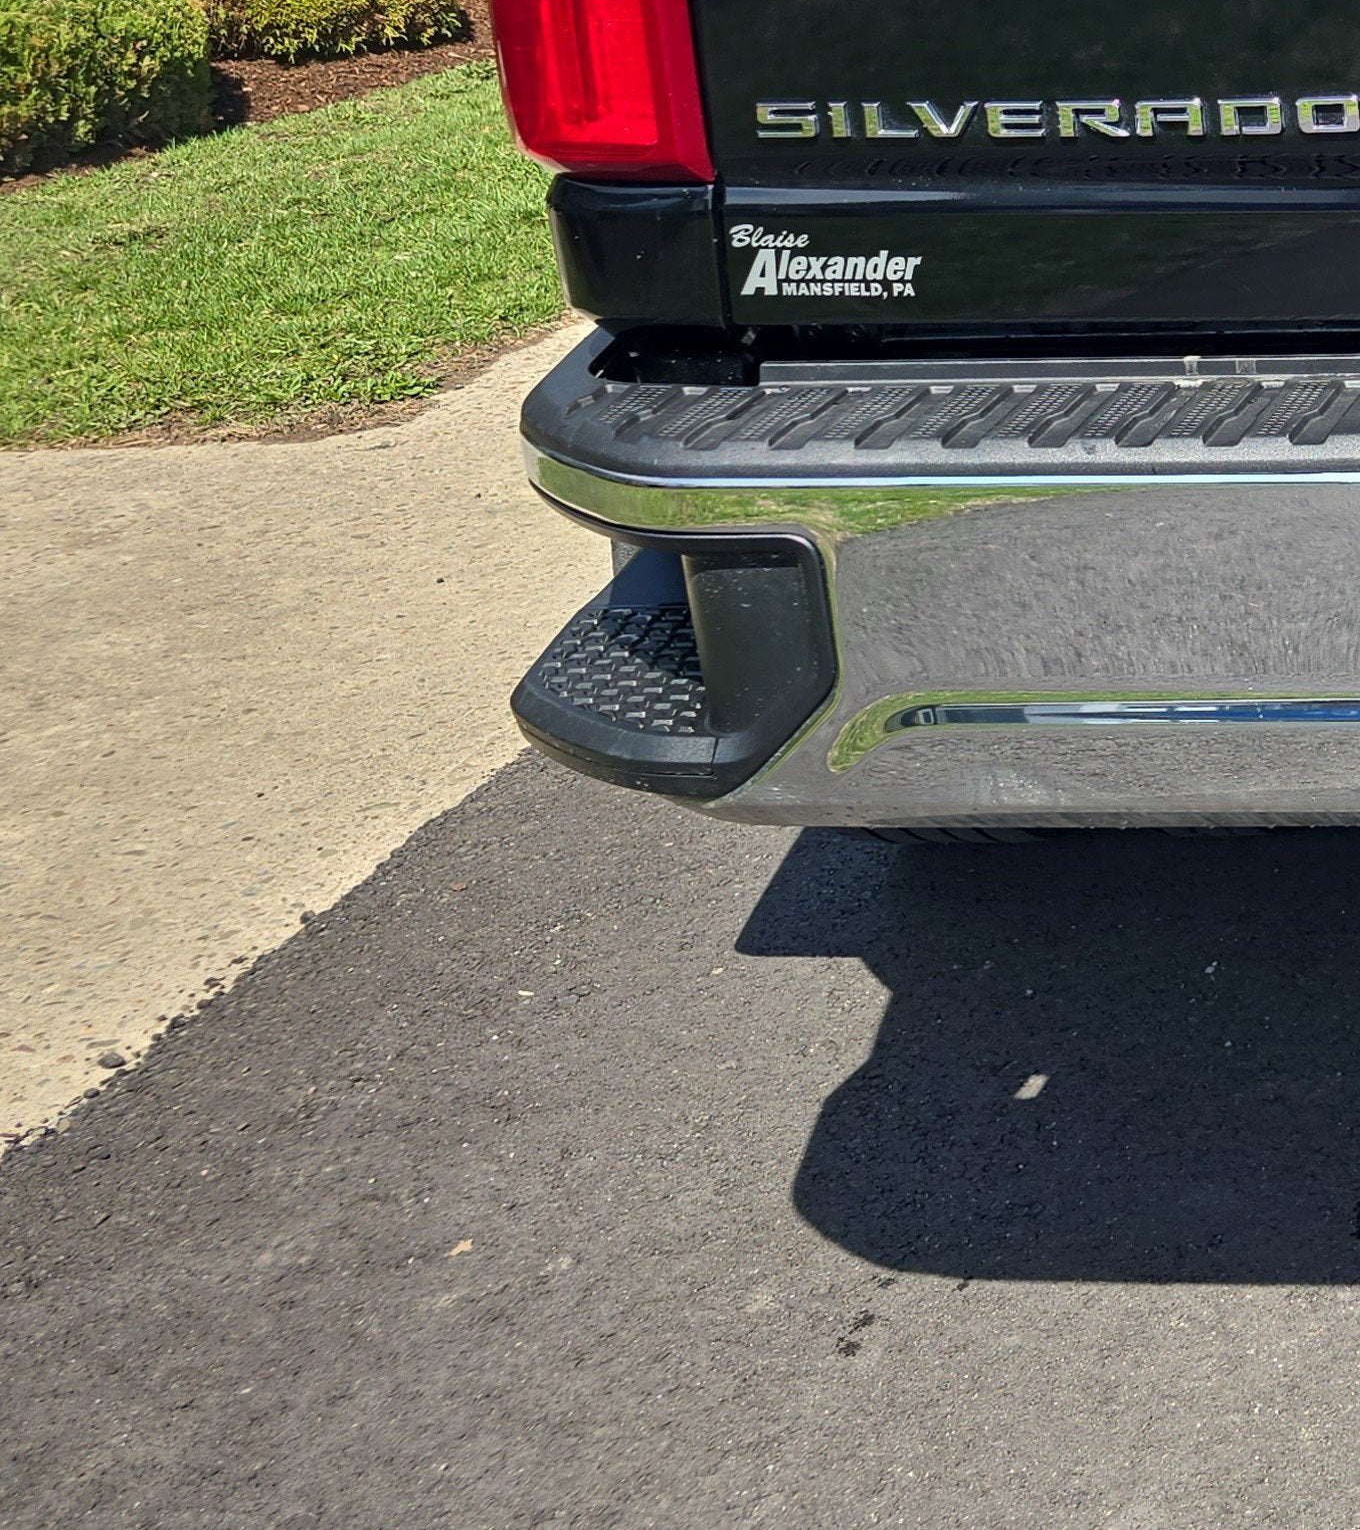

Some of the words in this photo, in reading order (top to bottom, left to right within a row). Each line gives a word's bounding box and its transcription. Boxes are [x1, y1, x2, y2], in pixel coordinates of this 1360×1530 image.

[729, 224, 810, 248] Blaise
[740, 248, 923, 296] Alexander
[782, 282, 888, 299] MANSFIELD,
[893, 282, 916, 297] PA
